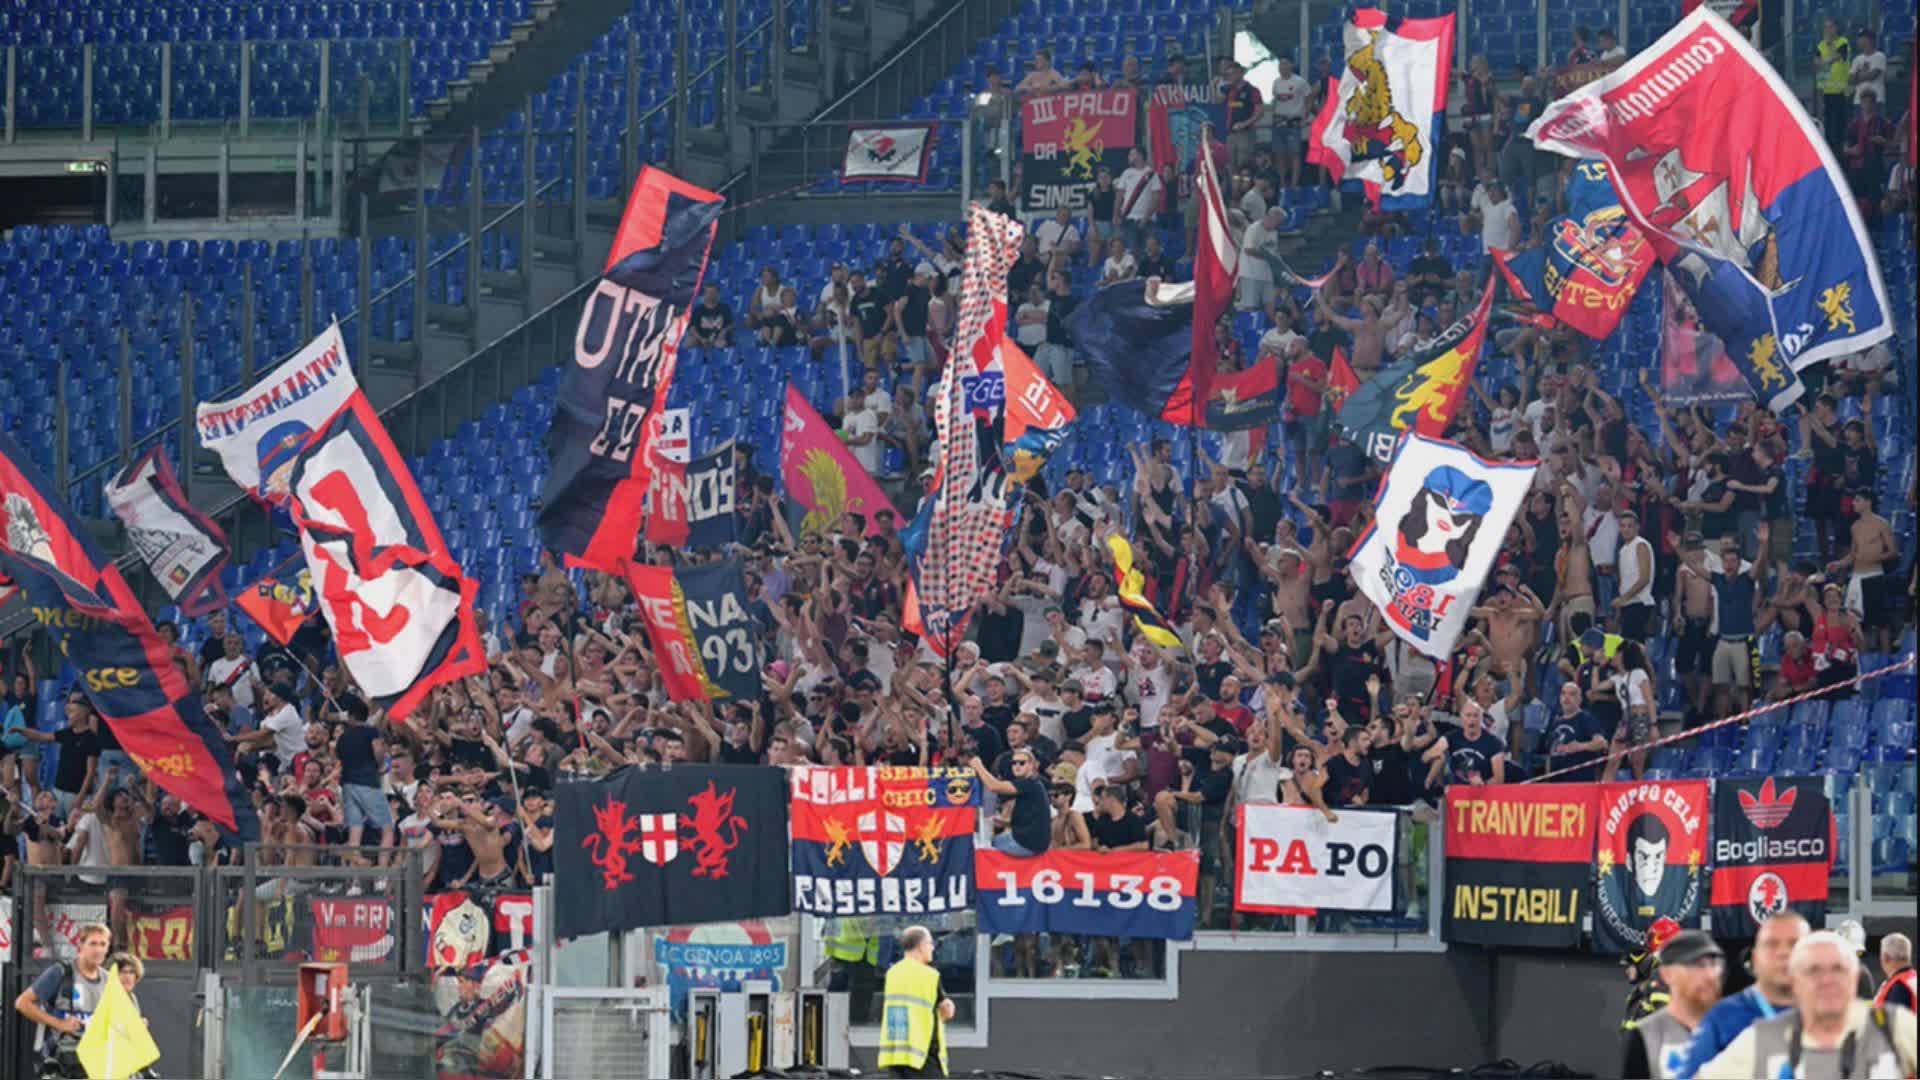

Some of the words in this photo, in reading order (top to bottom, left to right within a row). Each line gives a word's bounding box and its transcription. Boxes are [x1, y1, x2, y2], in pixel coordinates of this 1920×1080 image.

[1063, 92, 1130, 119] PALO
[1034, 142, 1057, 161] DA
[1028, 182, 1096, 208] SINIST
[883, 788, 937, 808] CHIC
[1606, 784, 1661, 835] GRUPPO
[1454, 800, 1586, 838] TRANVIERI
[1716, 836, 1825, 863] Bogliasco
[795, 874, 967, 914] ROSSOBLU
[996, 868, 1184, 911] 16138
[1453, 884, 1579, 924] INSTABILI
[684, 948, 745, 965] GENOA
